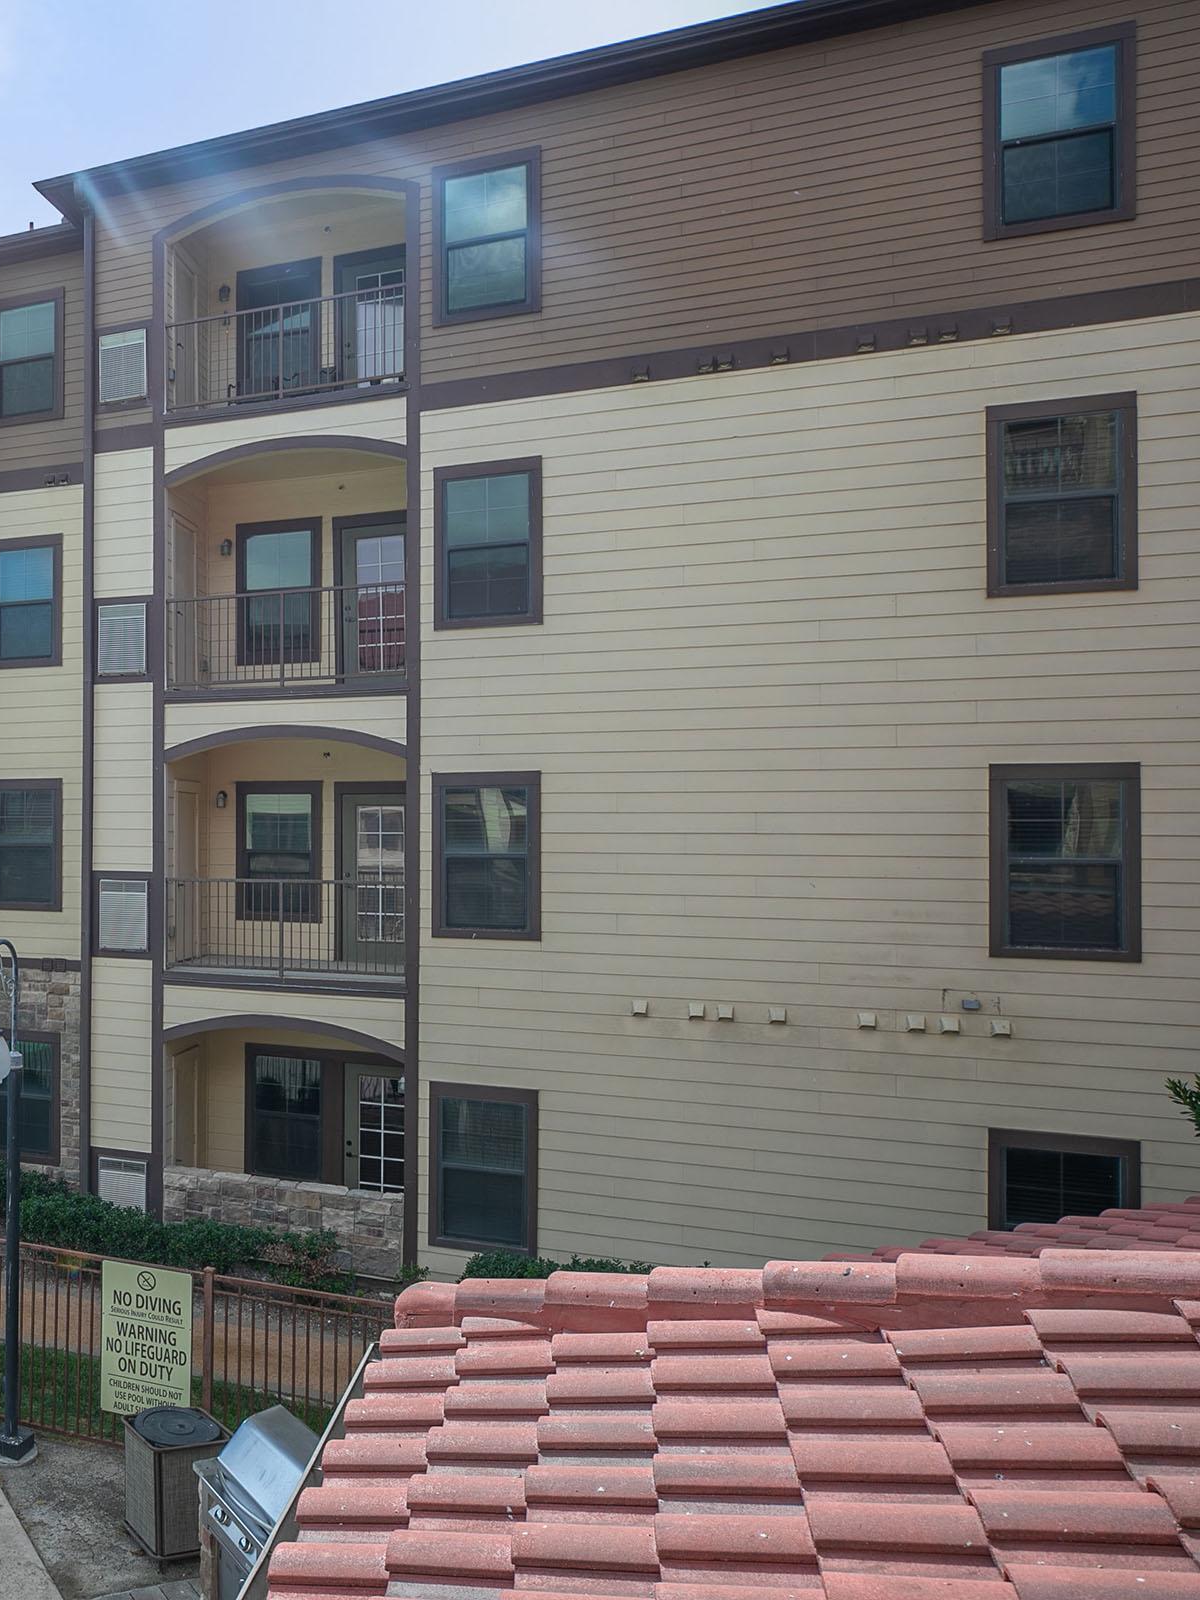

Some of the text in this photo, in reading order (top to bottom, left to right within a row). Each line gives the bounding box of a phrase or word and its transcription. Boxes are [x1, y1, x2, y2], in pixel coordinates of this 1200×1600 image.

[113, 1290, 181, 1315] NO DIVING
[117, 1321, 176, 1346] WARNING
[106, 1337, 187, 1366] NO LIFEGUARD
[118, 1357, 173, 1381] ON DUTY
[109, 1378, 182, 1400] CHILDREN SHOULD NOT
[115, 1391, 126, 1401] USE
[128, 1394, 144, 1404] POOL
[113, 1401, 134, 1412] ADULT
